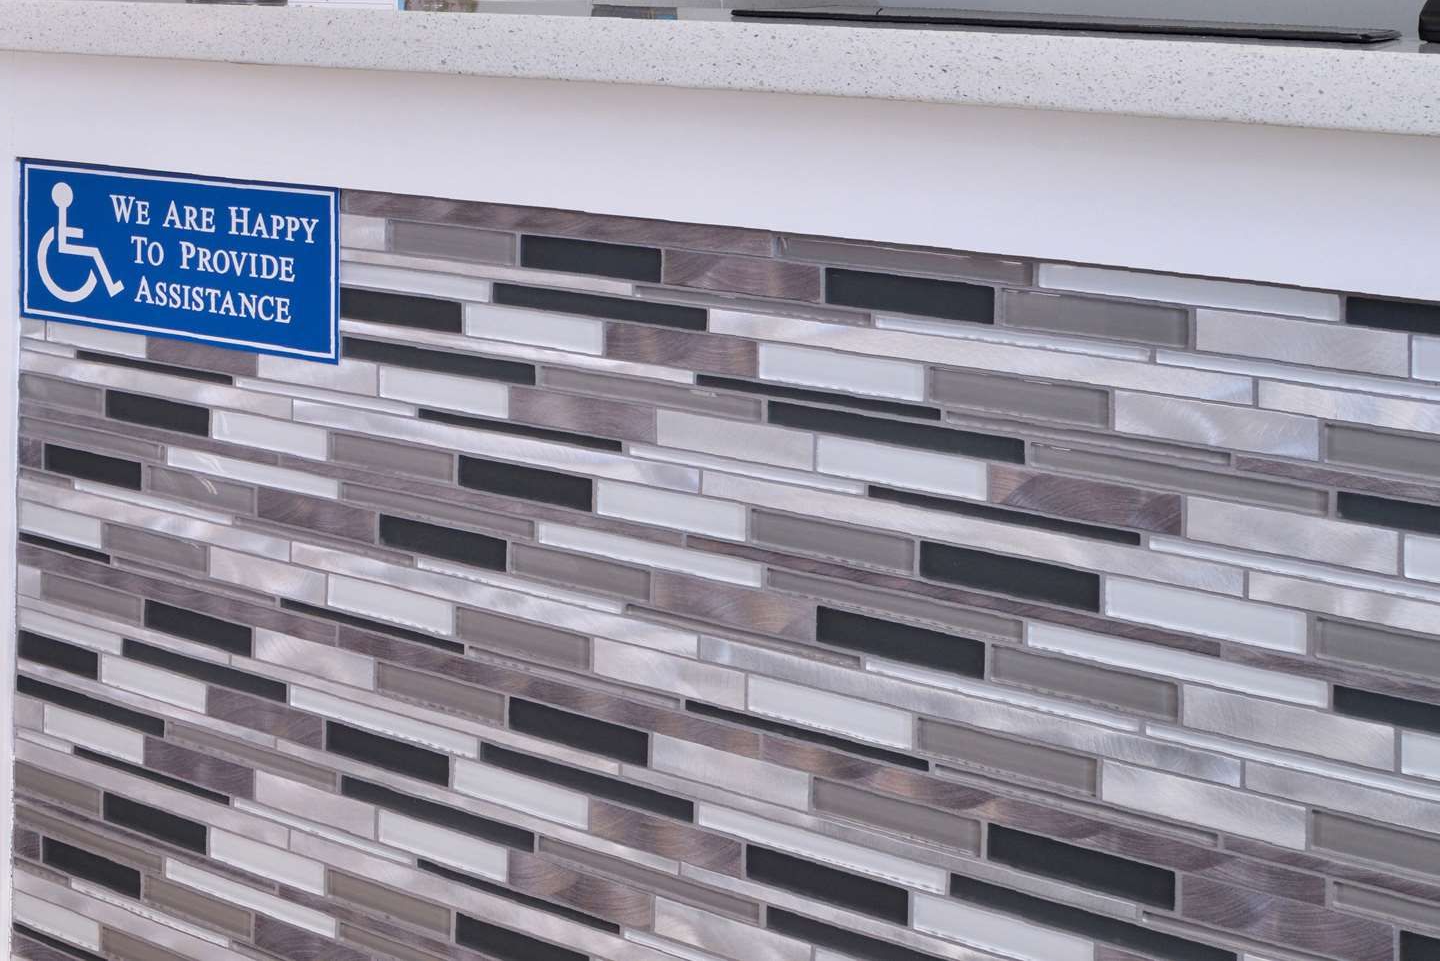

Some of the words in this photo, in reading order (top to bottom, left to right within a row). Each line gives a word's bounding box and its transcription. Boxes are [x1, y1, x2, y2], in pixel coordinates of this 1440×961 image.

[109, 194, 150, 226] WE
[162, 200, 216, 234] ARE
[228, 206, 319, 244] HAPPY
[131, 235, 164, 266] TO
[179, 241, 296, 283] PROVIDE
[134, 276, 291, 324] ASSISTANCE
